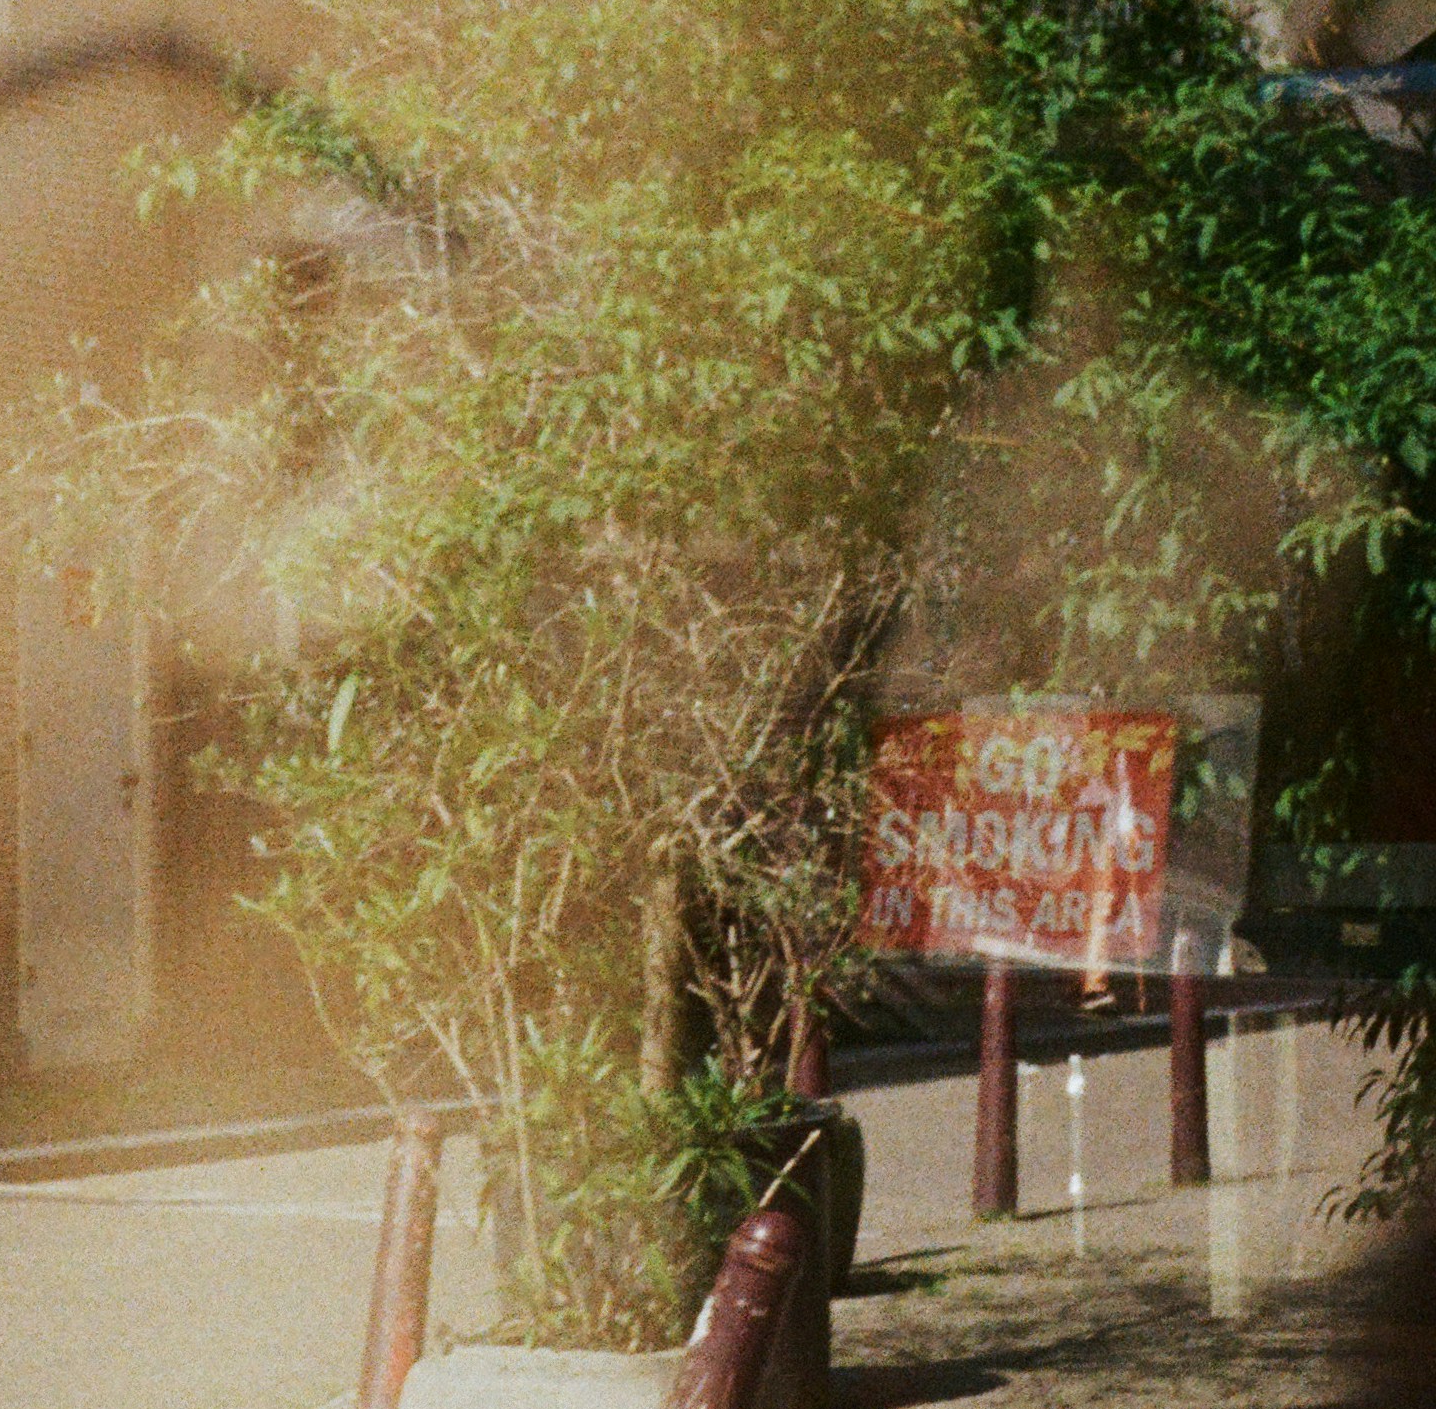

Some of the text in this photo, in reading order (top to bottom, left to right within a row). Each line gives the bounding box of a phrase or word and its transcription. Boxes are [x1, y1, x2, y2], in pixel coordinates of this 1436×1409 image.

[874, 808, 1156, 875] SMOKING
[872, 887, 1143, 936] IN THIS ARA
